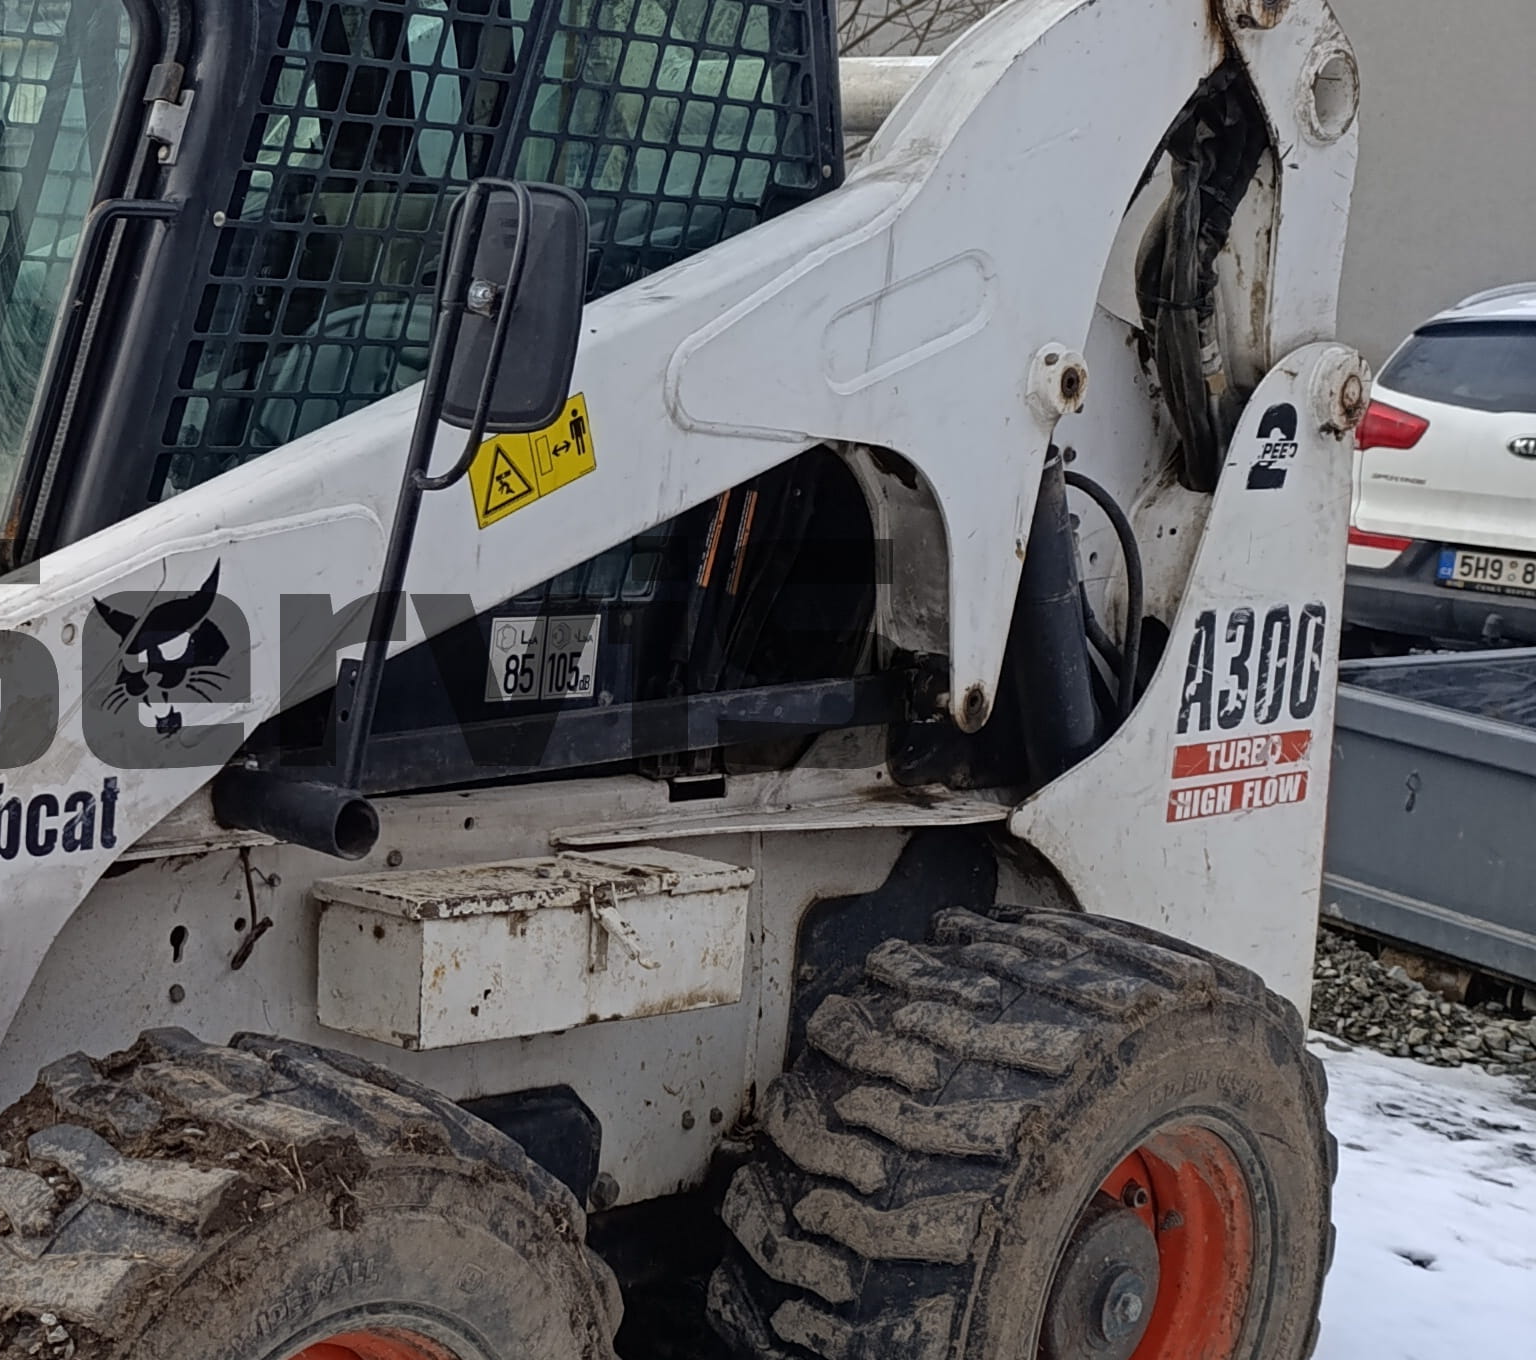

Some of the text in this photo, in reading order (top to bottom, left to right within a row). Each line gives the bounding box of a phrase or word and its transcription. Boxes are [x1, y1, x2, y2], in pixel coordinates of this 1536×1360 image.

[1257, 442, 1298, 459] PEED
[1514, 438, 1536, 456] KI
[1459, 555, 1503, 580] 5H9
[504, 654, 534, 694] 85
[1176, 600, 1326, 734] A300
[1207, 735, 1283, 772] TURBO
[1175, 773, 1302, 820] HIGH FLOW
